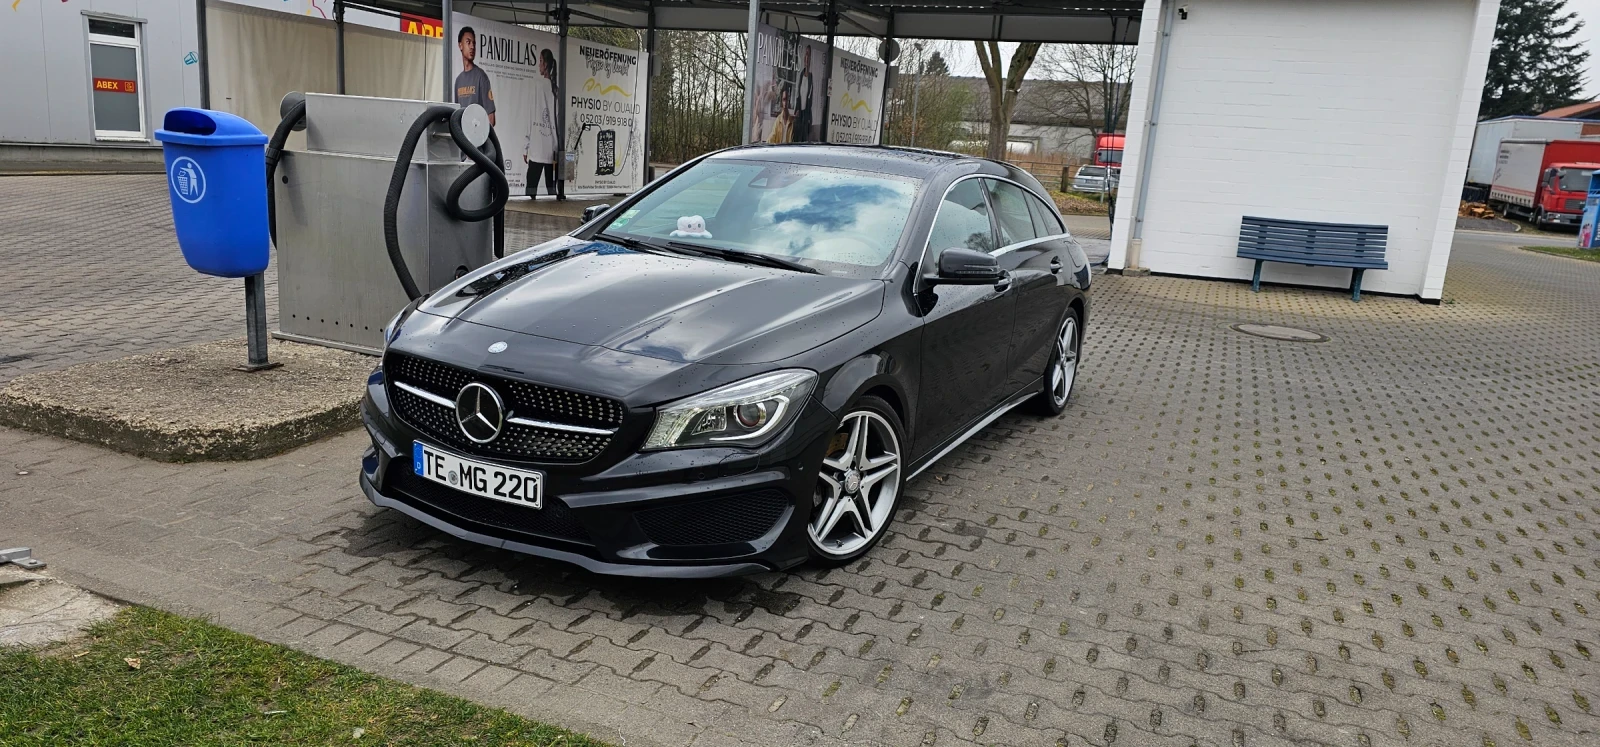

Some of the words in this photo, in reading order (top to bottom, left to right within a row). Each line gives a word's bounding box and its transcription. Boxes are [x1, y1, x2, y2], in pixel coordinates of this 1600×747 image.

[480, 34, 537, 66] PANDILLAS
[579, 45, 636, 65] NEUERÖFFNUNG
[96, 80, 118, 90] ABEX
[571, 96, 601, 110] PHYSIO
[603, 100, 612, 111] BY
[614, 102, 640, 114] OUALD
[831, 113, 852, 127] PHYSIO
[424, 450, 446, 481] TE
[459, 463, 487, 493] MG
[493, 471, 538, 503] 220
